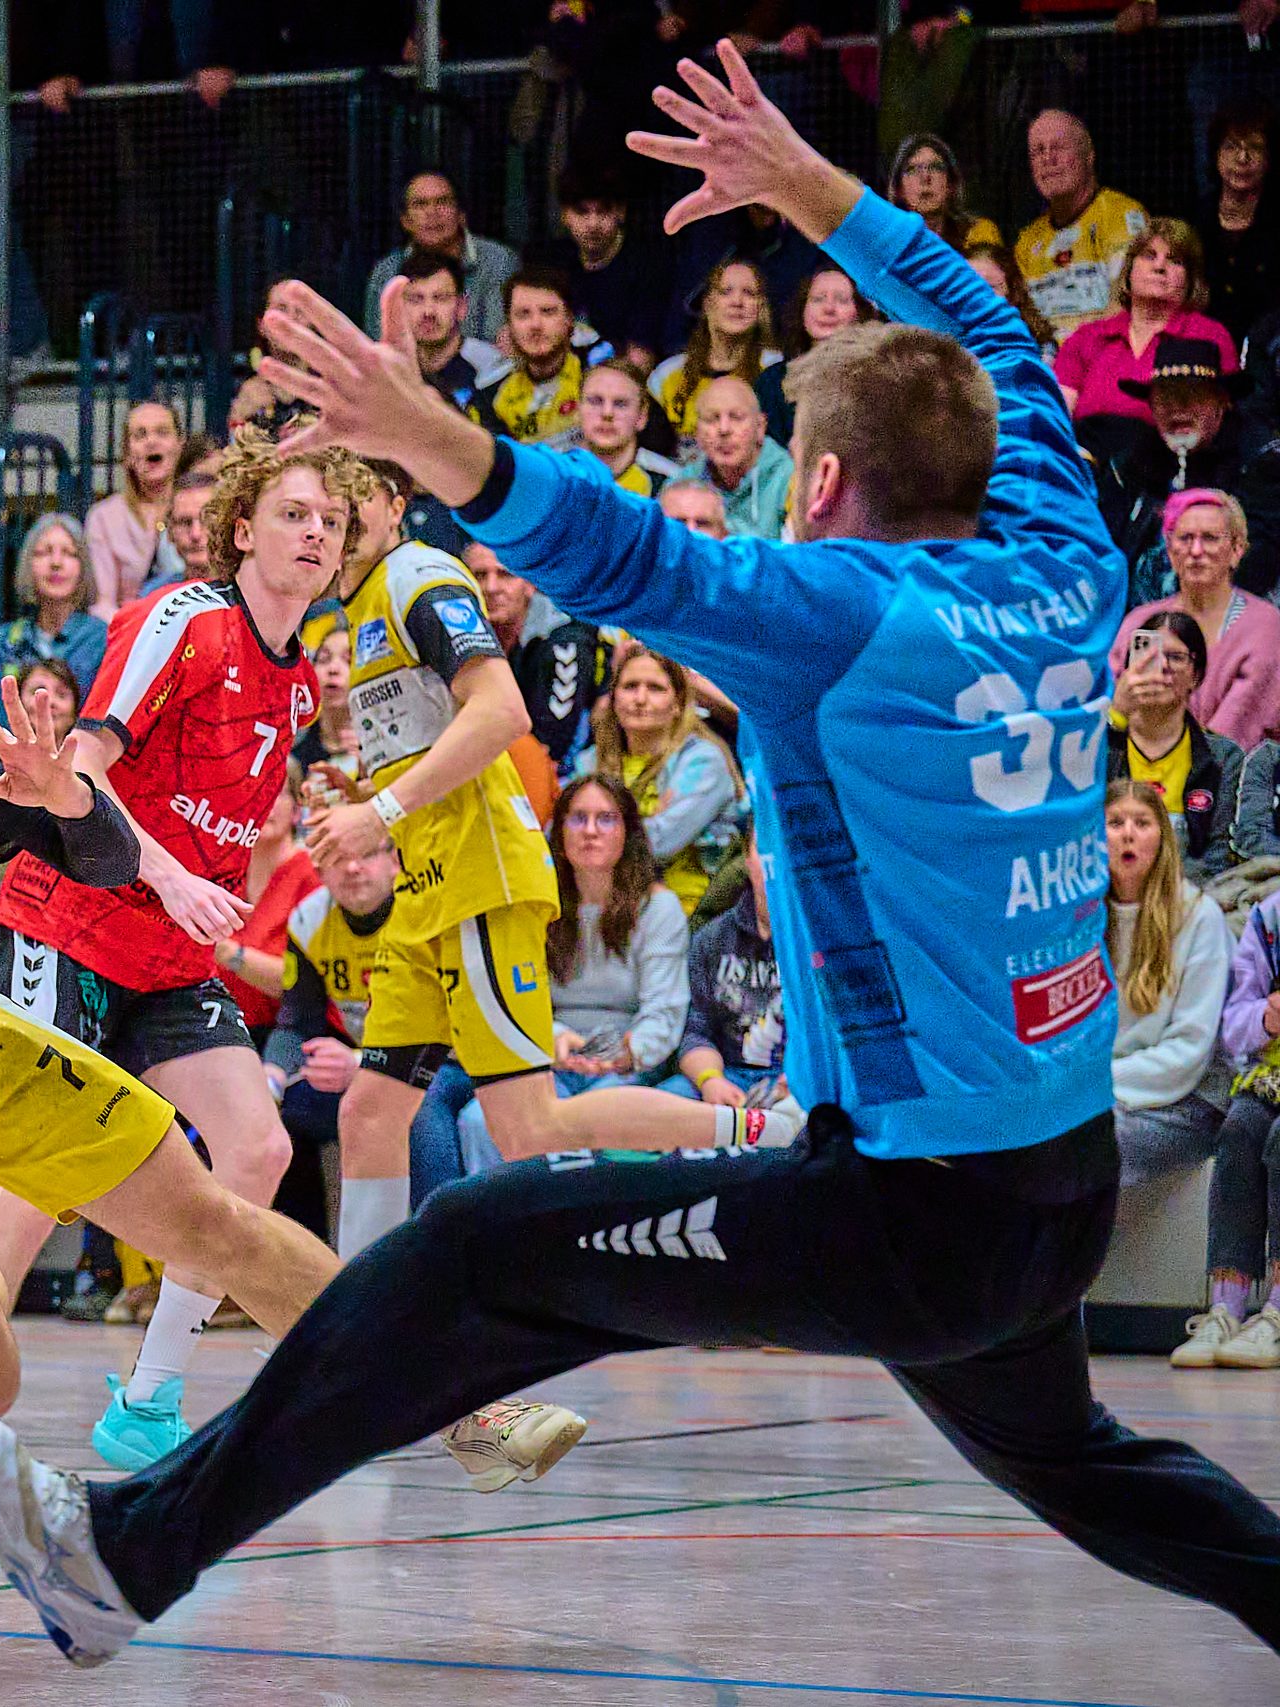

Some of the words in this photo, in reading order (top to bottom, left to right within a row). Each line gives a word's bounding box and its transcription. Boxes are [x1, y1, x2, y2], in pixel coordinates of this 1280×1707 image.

[248, 721, 279, 777] 7
[202, 1001, 222, 1029] 7
[36, 1044, 87, 1092] 7
[96, 1085, 131, 1128] HALLENKIND
